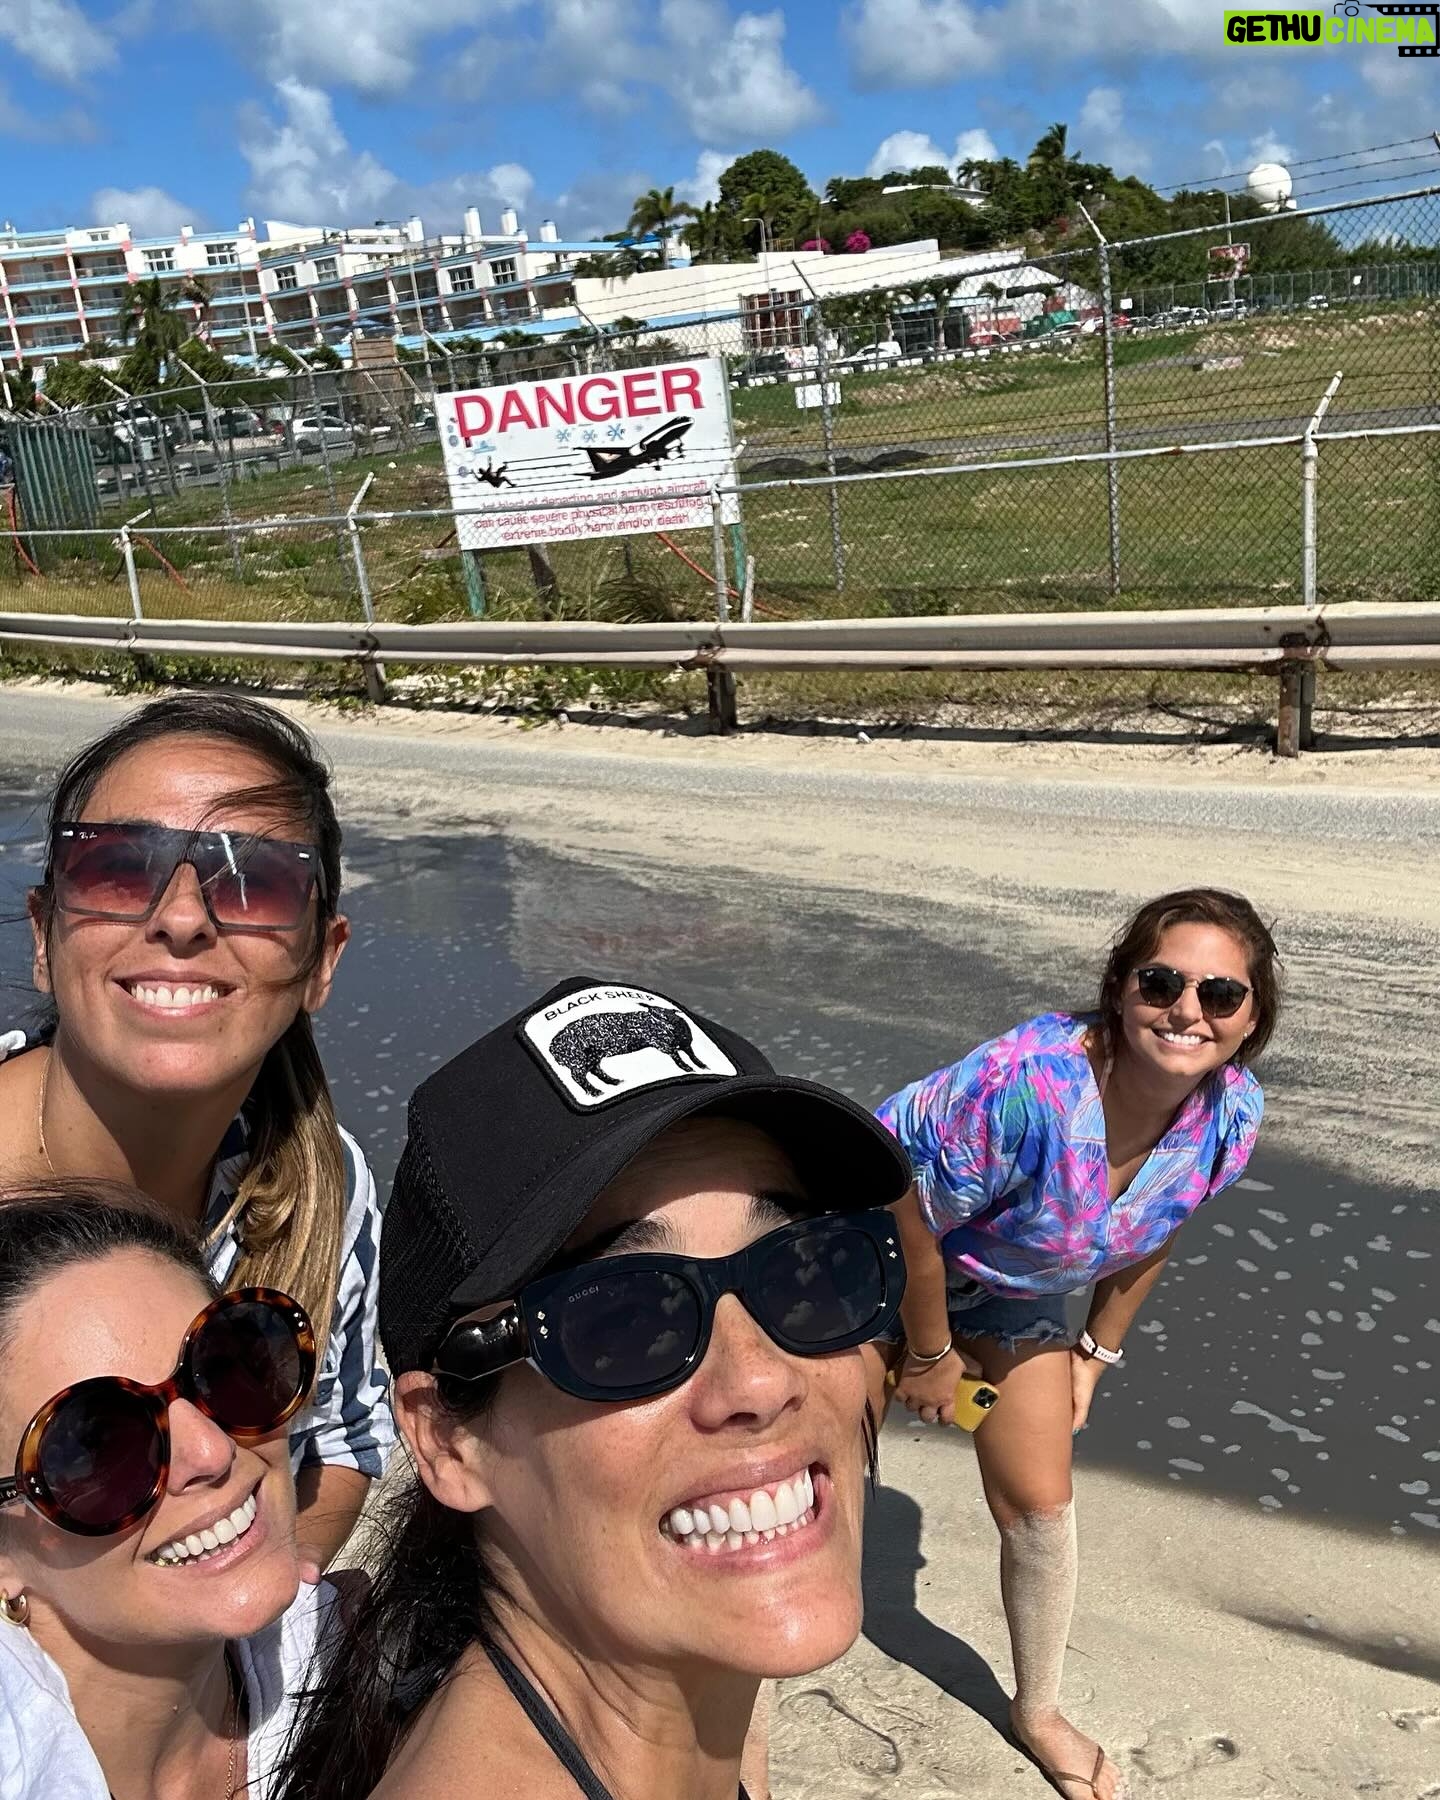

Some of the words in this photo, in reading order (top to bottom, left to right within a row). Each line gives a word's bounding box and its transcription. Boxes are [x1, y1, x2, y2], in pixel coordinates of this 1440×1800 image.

[454, 367, 704, 436] DANGER
[474, 518, 495, 528] can
[531, 512, 568, 523] severe
[657, 513, 690, 526] death
[545, 992, 602, 1021] BLACK
[568, 1285, 600, 1303] GUCCI
